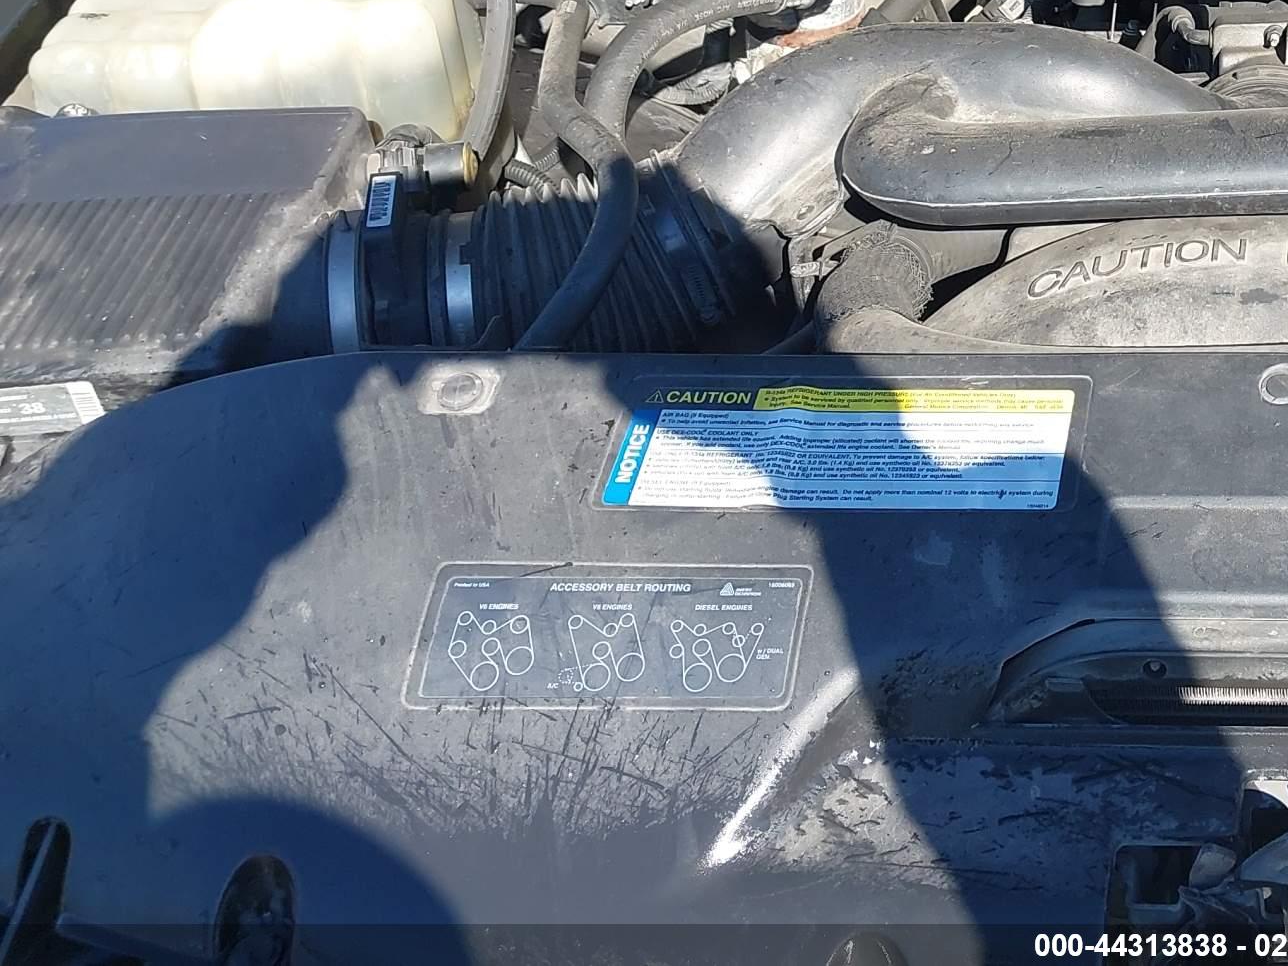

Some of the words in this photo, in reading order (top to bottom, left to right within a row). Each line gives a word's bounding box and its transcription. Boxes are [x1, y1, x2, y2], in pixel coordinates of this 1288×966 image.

[1027, 237, 1249, 300] CAUTION
[666, 390, 752, 404] CAUTION
[615, 424, 650, 483] NOTICE
[550, 582, 614, 592] ACCESSORY
[615, 583, 643, 592] BELT
[644, 584, 692, 592] ROUTING
